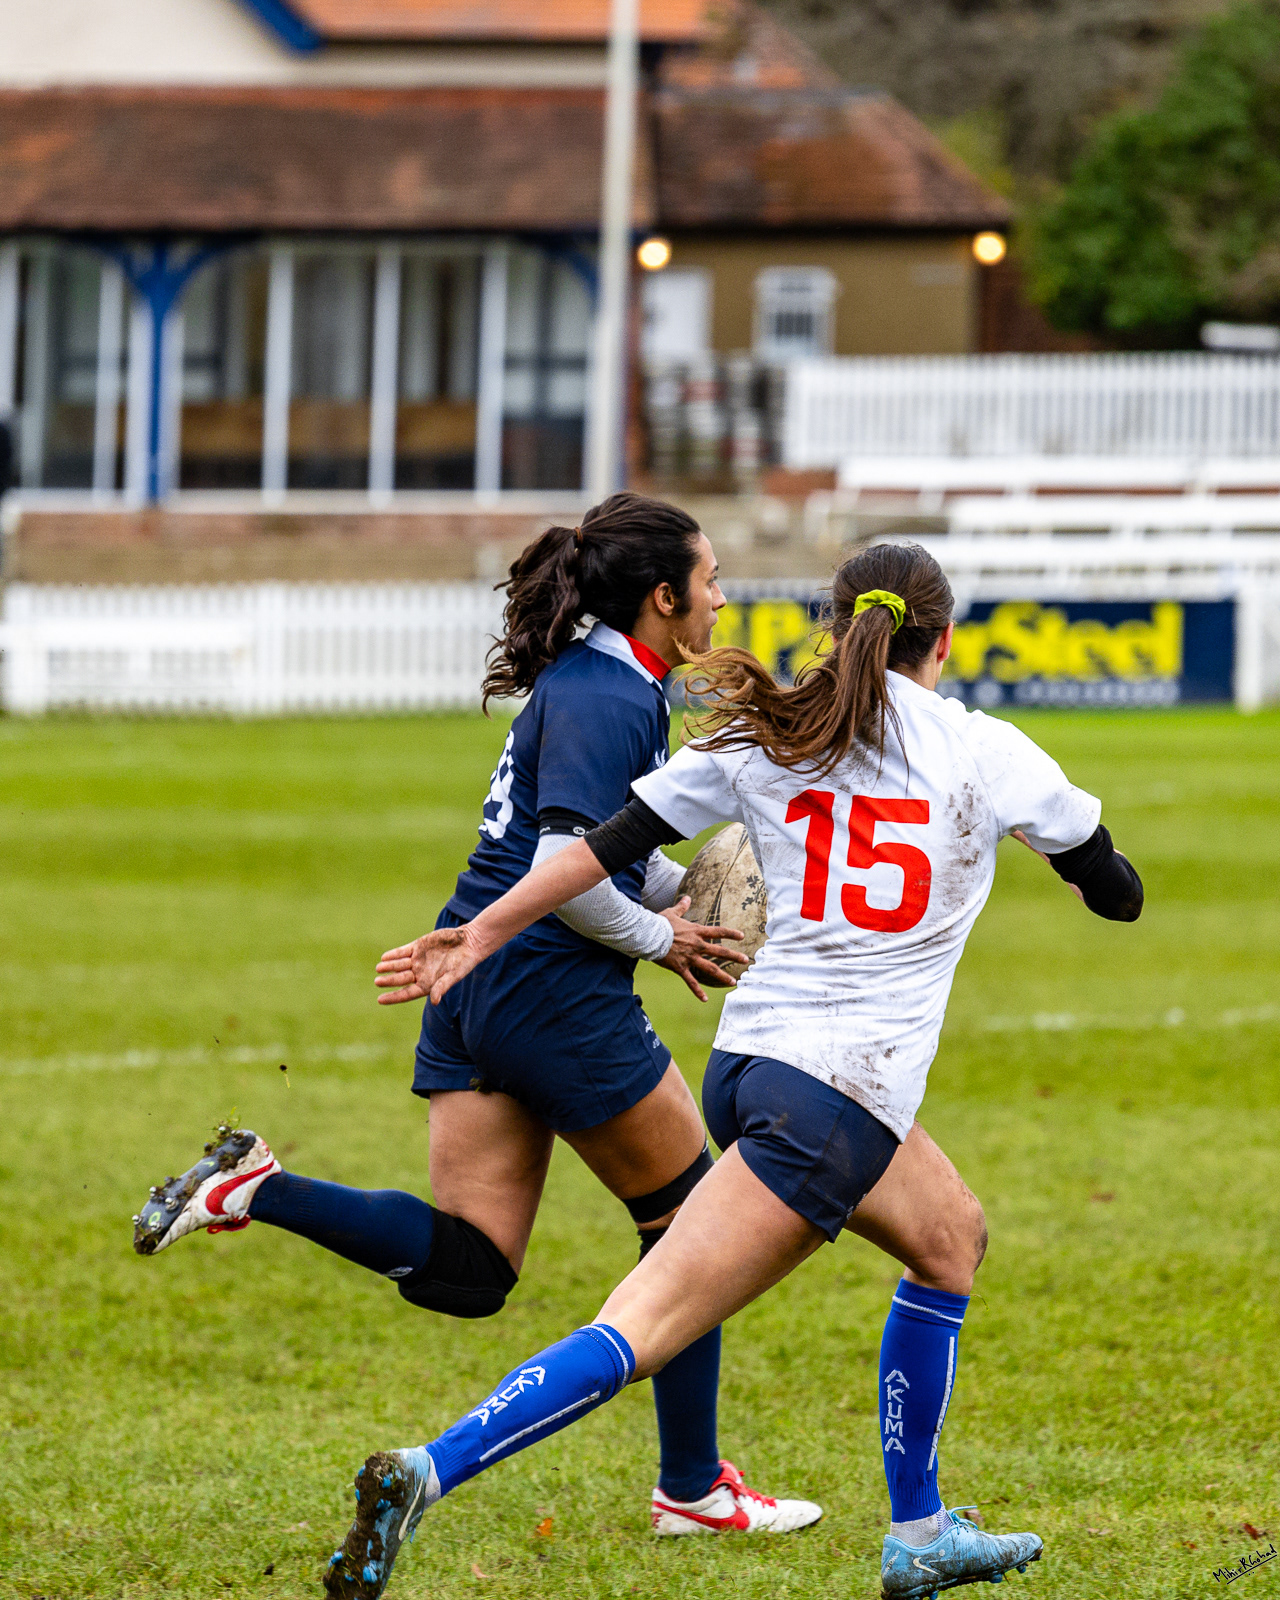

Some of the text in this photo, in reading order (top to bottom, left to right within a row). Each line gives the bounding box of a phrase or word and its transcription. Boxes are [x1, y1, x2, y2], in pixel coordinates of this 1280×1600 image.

[785, 788, 932, 933] 15
[467, 1365, 546, 1427] AKUMA
[884, 1369, 910, 1455] AKUMA
